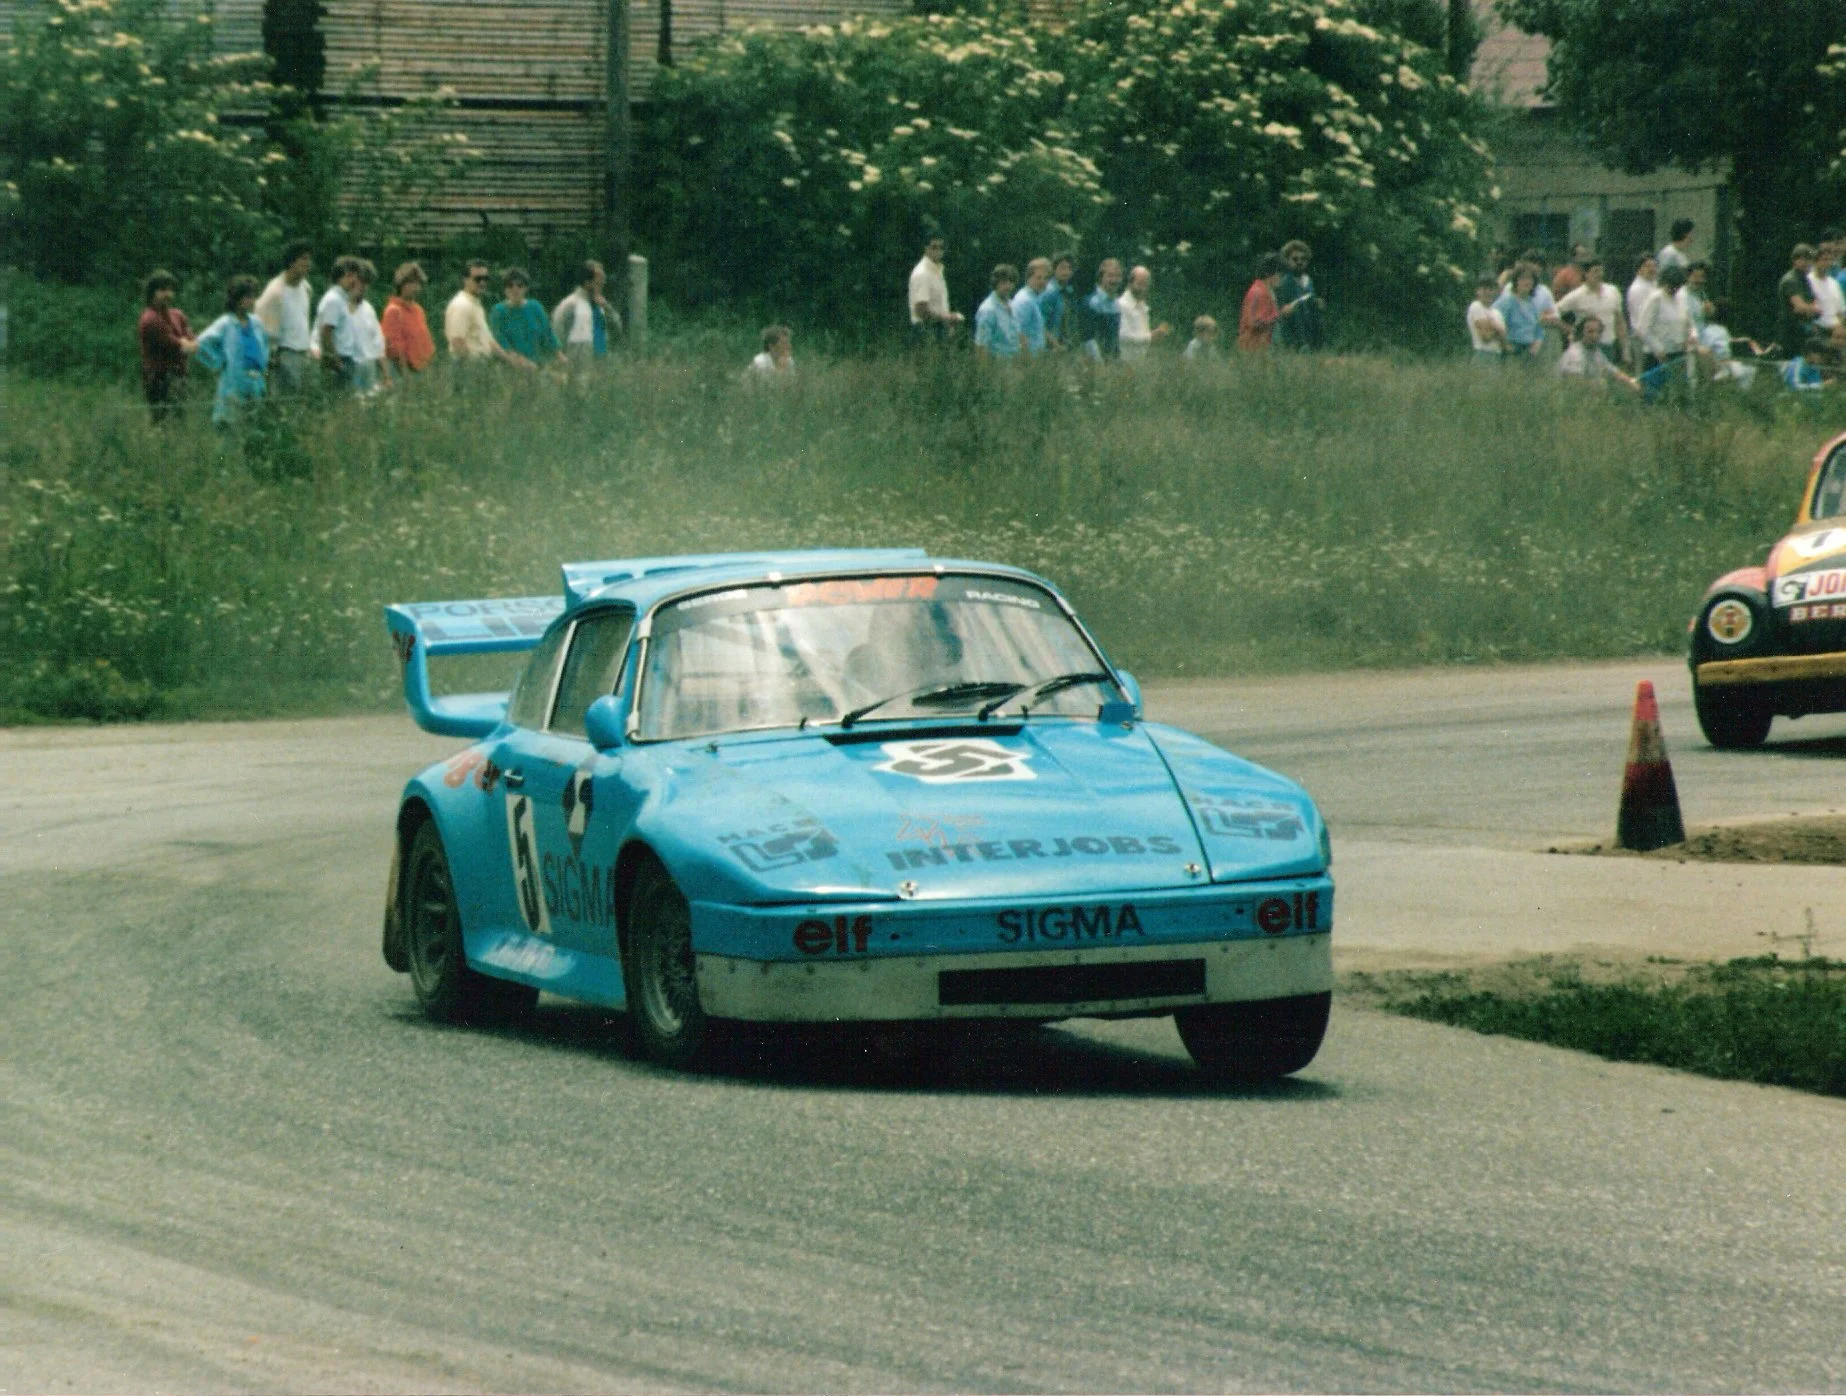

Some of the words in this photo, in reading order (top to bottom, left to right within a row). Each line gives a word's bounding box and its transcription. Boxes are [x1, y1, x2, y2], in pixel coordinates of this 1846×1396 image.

[887, 836, 1183, 871] INTERJOBS
[996, 903, 1145, 944] SIGMA
[1257, 892, 1319, 934] elf
[793, 914, 873, 954] elf
